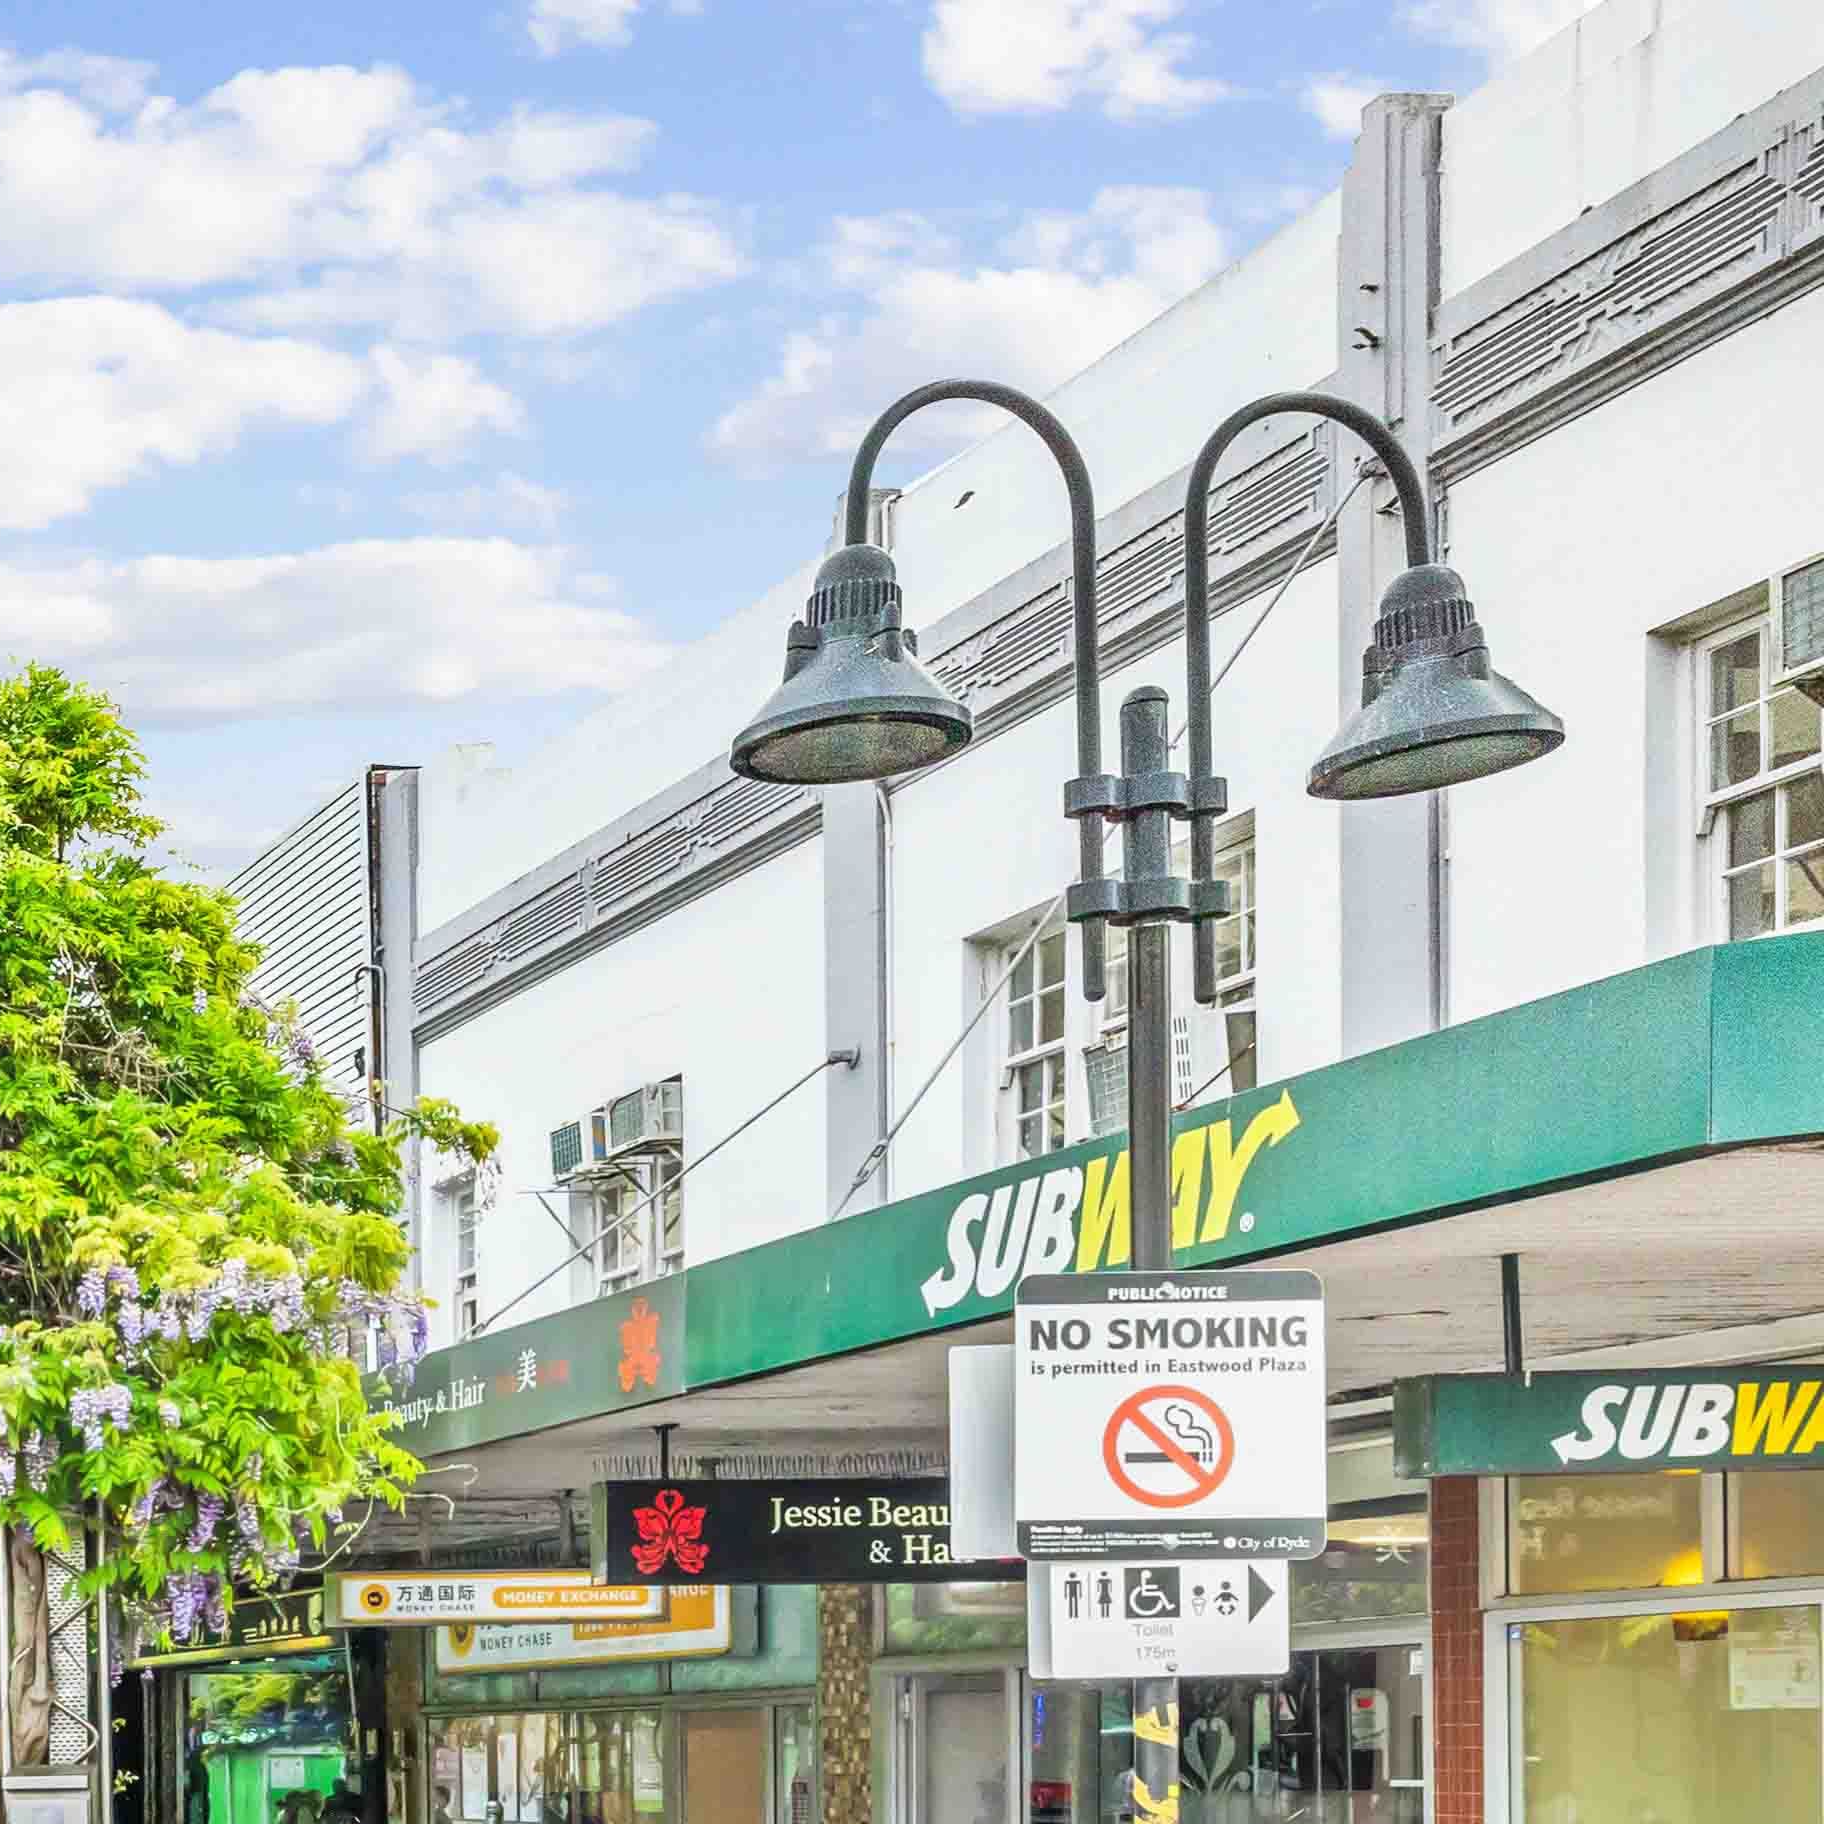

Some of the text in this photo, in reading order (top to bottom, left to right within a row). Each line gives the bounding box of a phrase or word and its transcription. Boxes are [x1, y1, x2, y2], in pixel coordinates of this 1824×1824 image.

[1107, 1286, 1164, 1300] PUBLIC
[1029, 1316, 1308, 1351] NO SMOKING
[1031, 1356, 1307, 1379] is permitted in Eastwood Plaza
[451, 1375, 487, 1410] Hair
[1550, 1380, 1824, 1465] SUBW
[770, 1496, 951, 1534] Jessie Beau
[868, 1534, 976, 1564] & Ha
[1238, 1536, 1311, 1551] City of Ryde
[396, 1584, 476, 1602] 万通国际
[503, 1589, 639, 1604] MONEY EXCHANGE
[396, 1604, 475, 1613] MONEY CHASE
[1134, 1622, 1175, 1638] Toilet
[480, 1632, 552, 1652] MONEY CHASE
[1136, 1646, 1176, 1660] 175m
